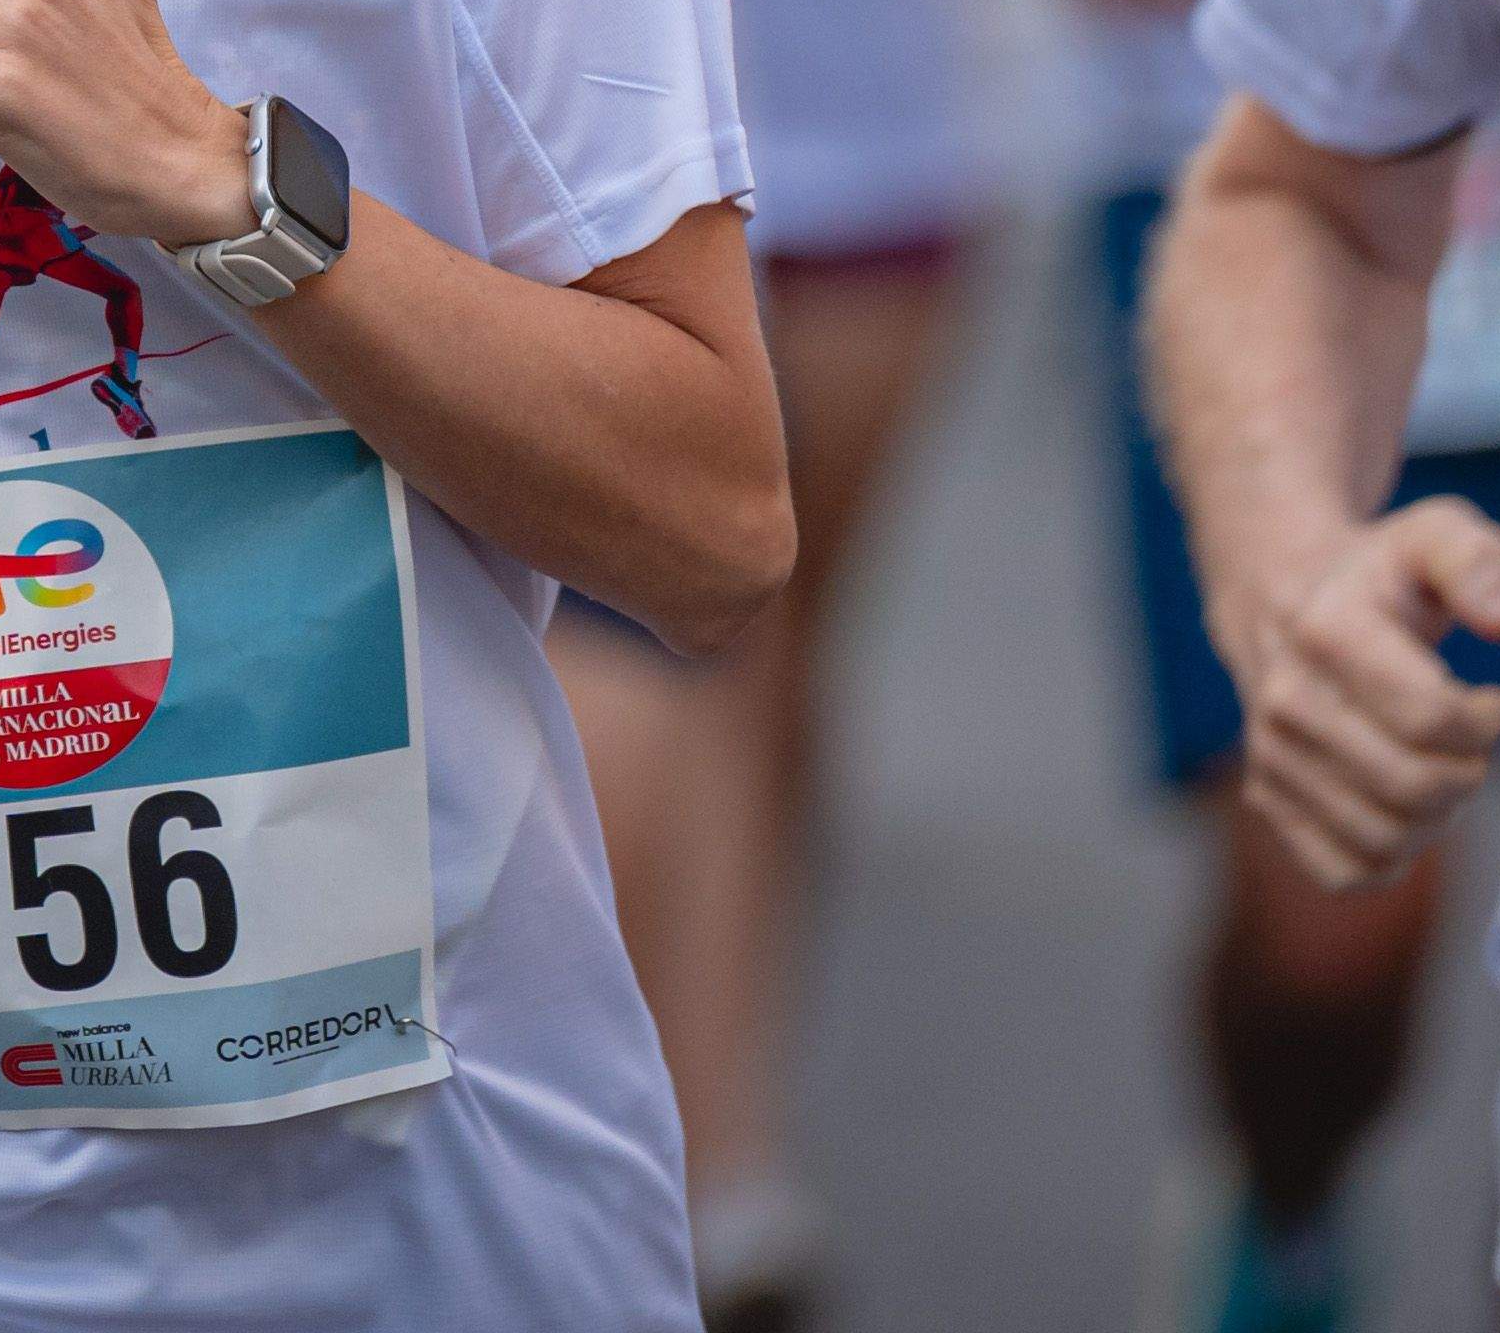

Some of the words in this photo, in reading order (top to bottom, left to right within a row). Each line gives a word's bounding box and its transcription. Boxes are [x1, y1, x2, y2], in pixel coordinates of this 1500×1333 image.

[6, 730, 111, 763] MADRID
[56, 1027, 80, 1039] new
[82, 1023, 132, 1037] balance
[61, 1036, 157, 1062] MILLA
[69, 1061, 174, 1086] URBANA
